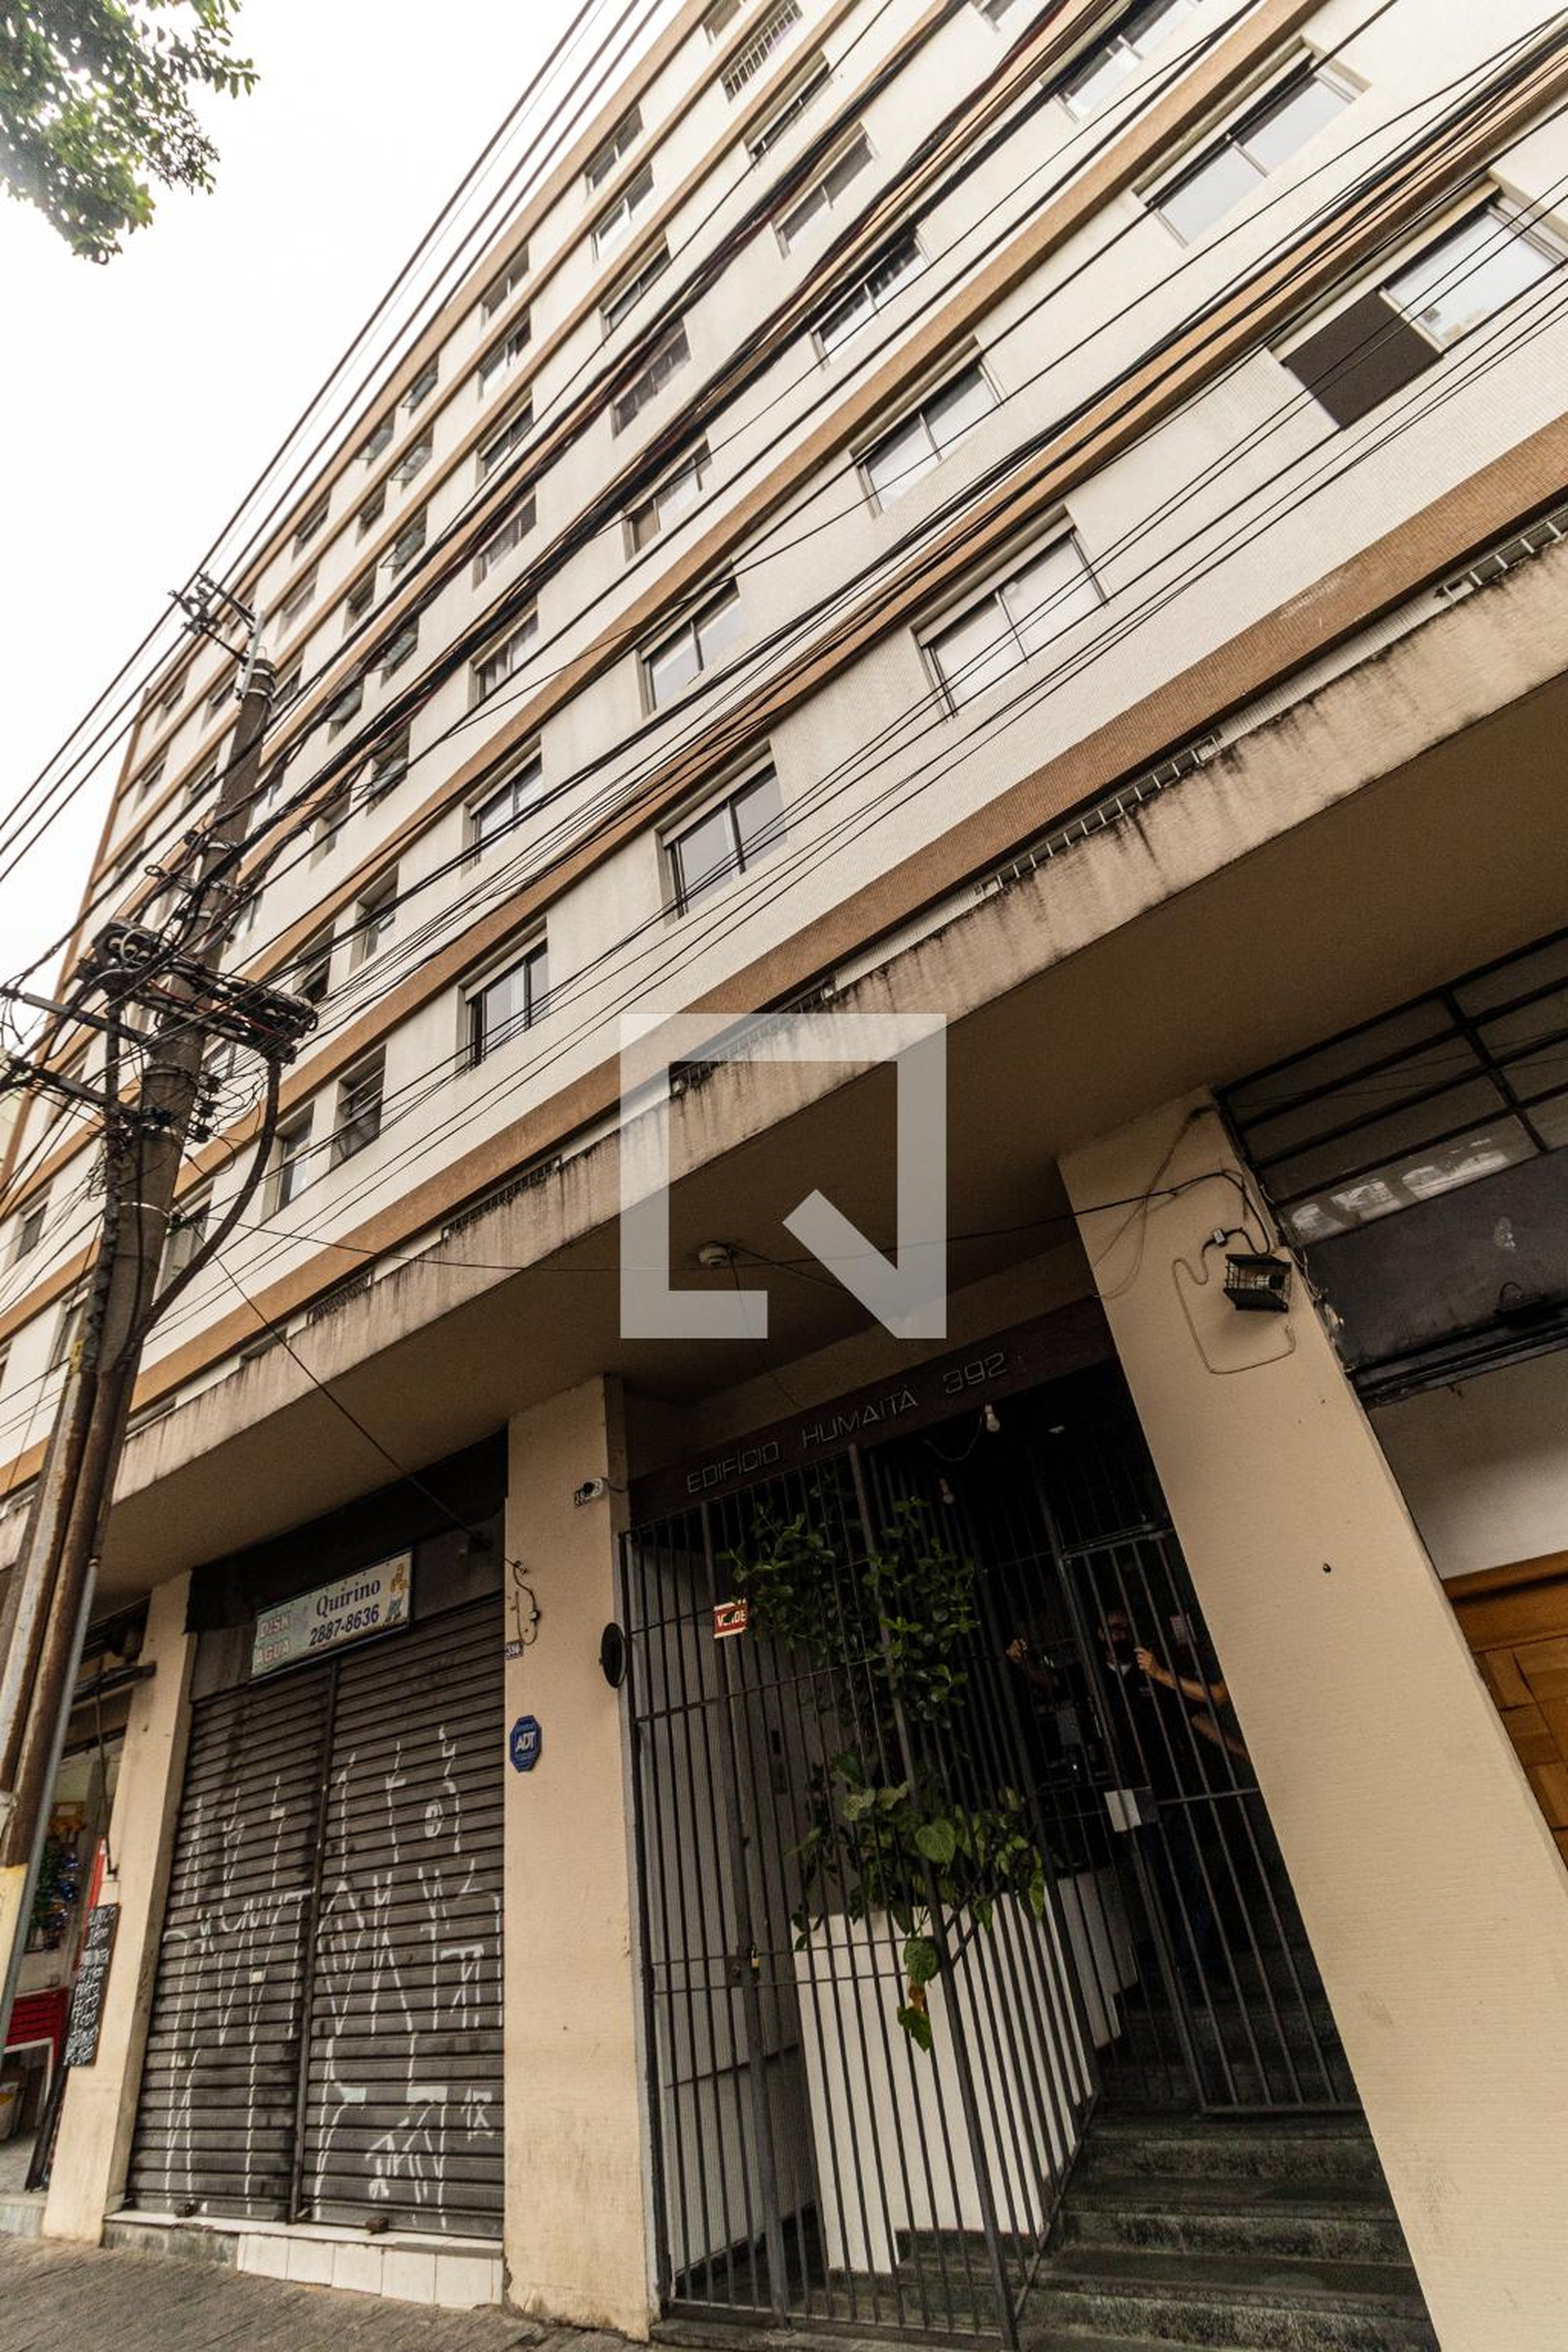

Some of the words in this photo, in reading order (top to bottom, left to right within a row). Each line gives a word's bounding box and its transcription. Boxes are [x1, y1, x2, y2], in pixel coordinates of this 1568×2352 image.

[687, 1441, 780, 1494] EDIFICIO
[943, 1352, 1007, 1394] 392
[316, 1579, 381, 1618] Quirino
[717, 1609, 746, 1627] VDE
[309, 1604, 379, 1647] 2887-8636
[515, 1731, 537, 1752] ADT
